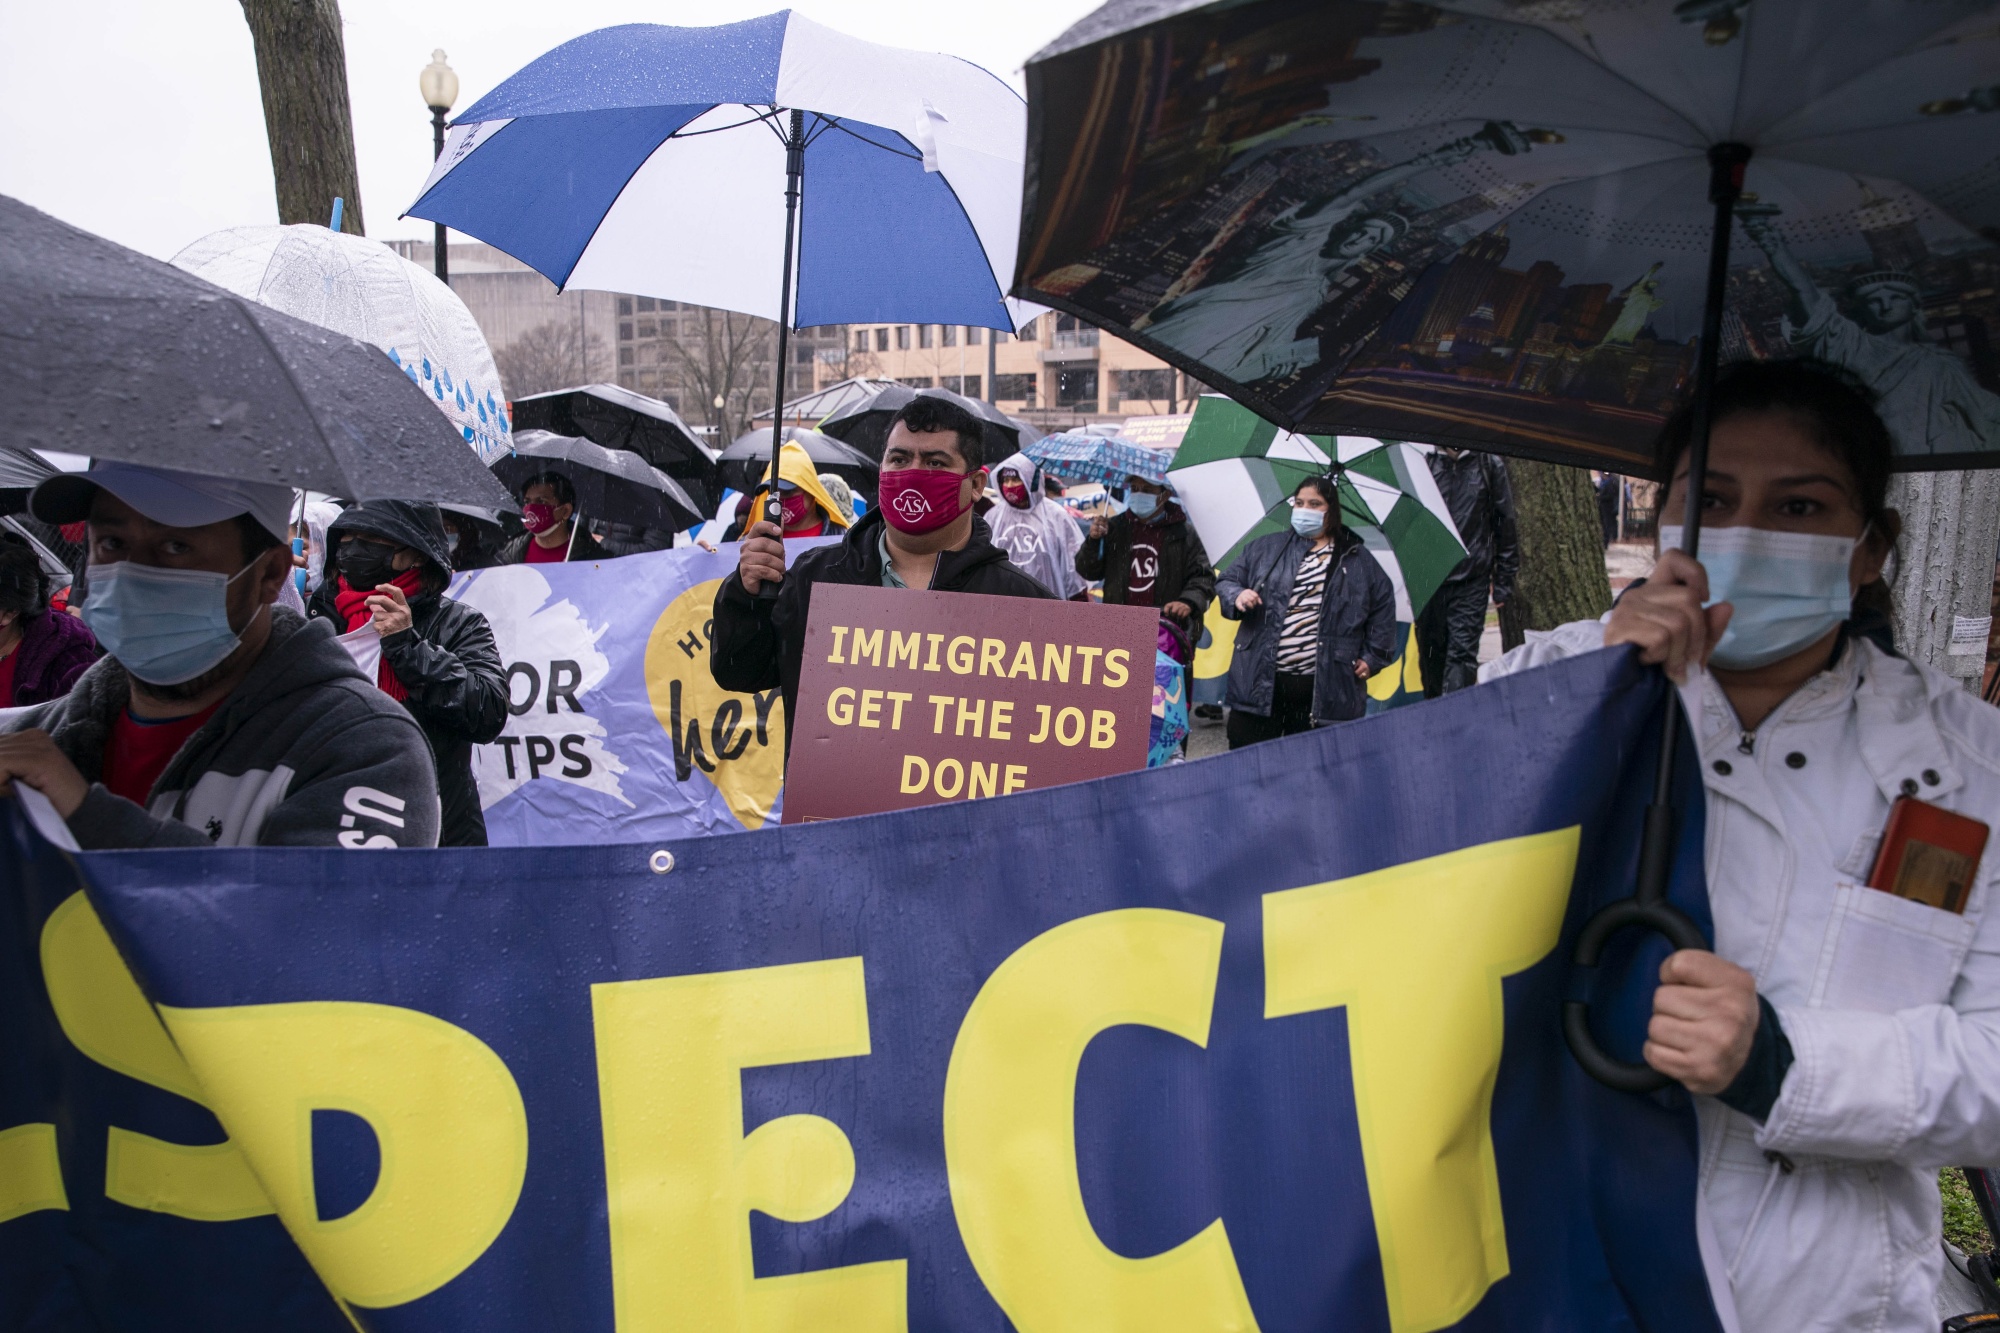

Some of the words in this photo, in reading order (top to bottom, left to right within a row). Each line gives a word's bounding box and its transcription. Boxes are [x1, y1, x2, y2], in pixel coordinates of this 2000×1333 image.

[892, 497, 932, 513] CASA
[827, 625, 1131, 688] IMMIGRANTS
[826, 686, 913, 730] GET
[928, 695, 1014, 740] THE
[1028, 704, 1118, 749] JOB
[493, 733, 593, 780] TPS
